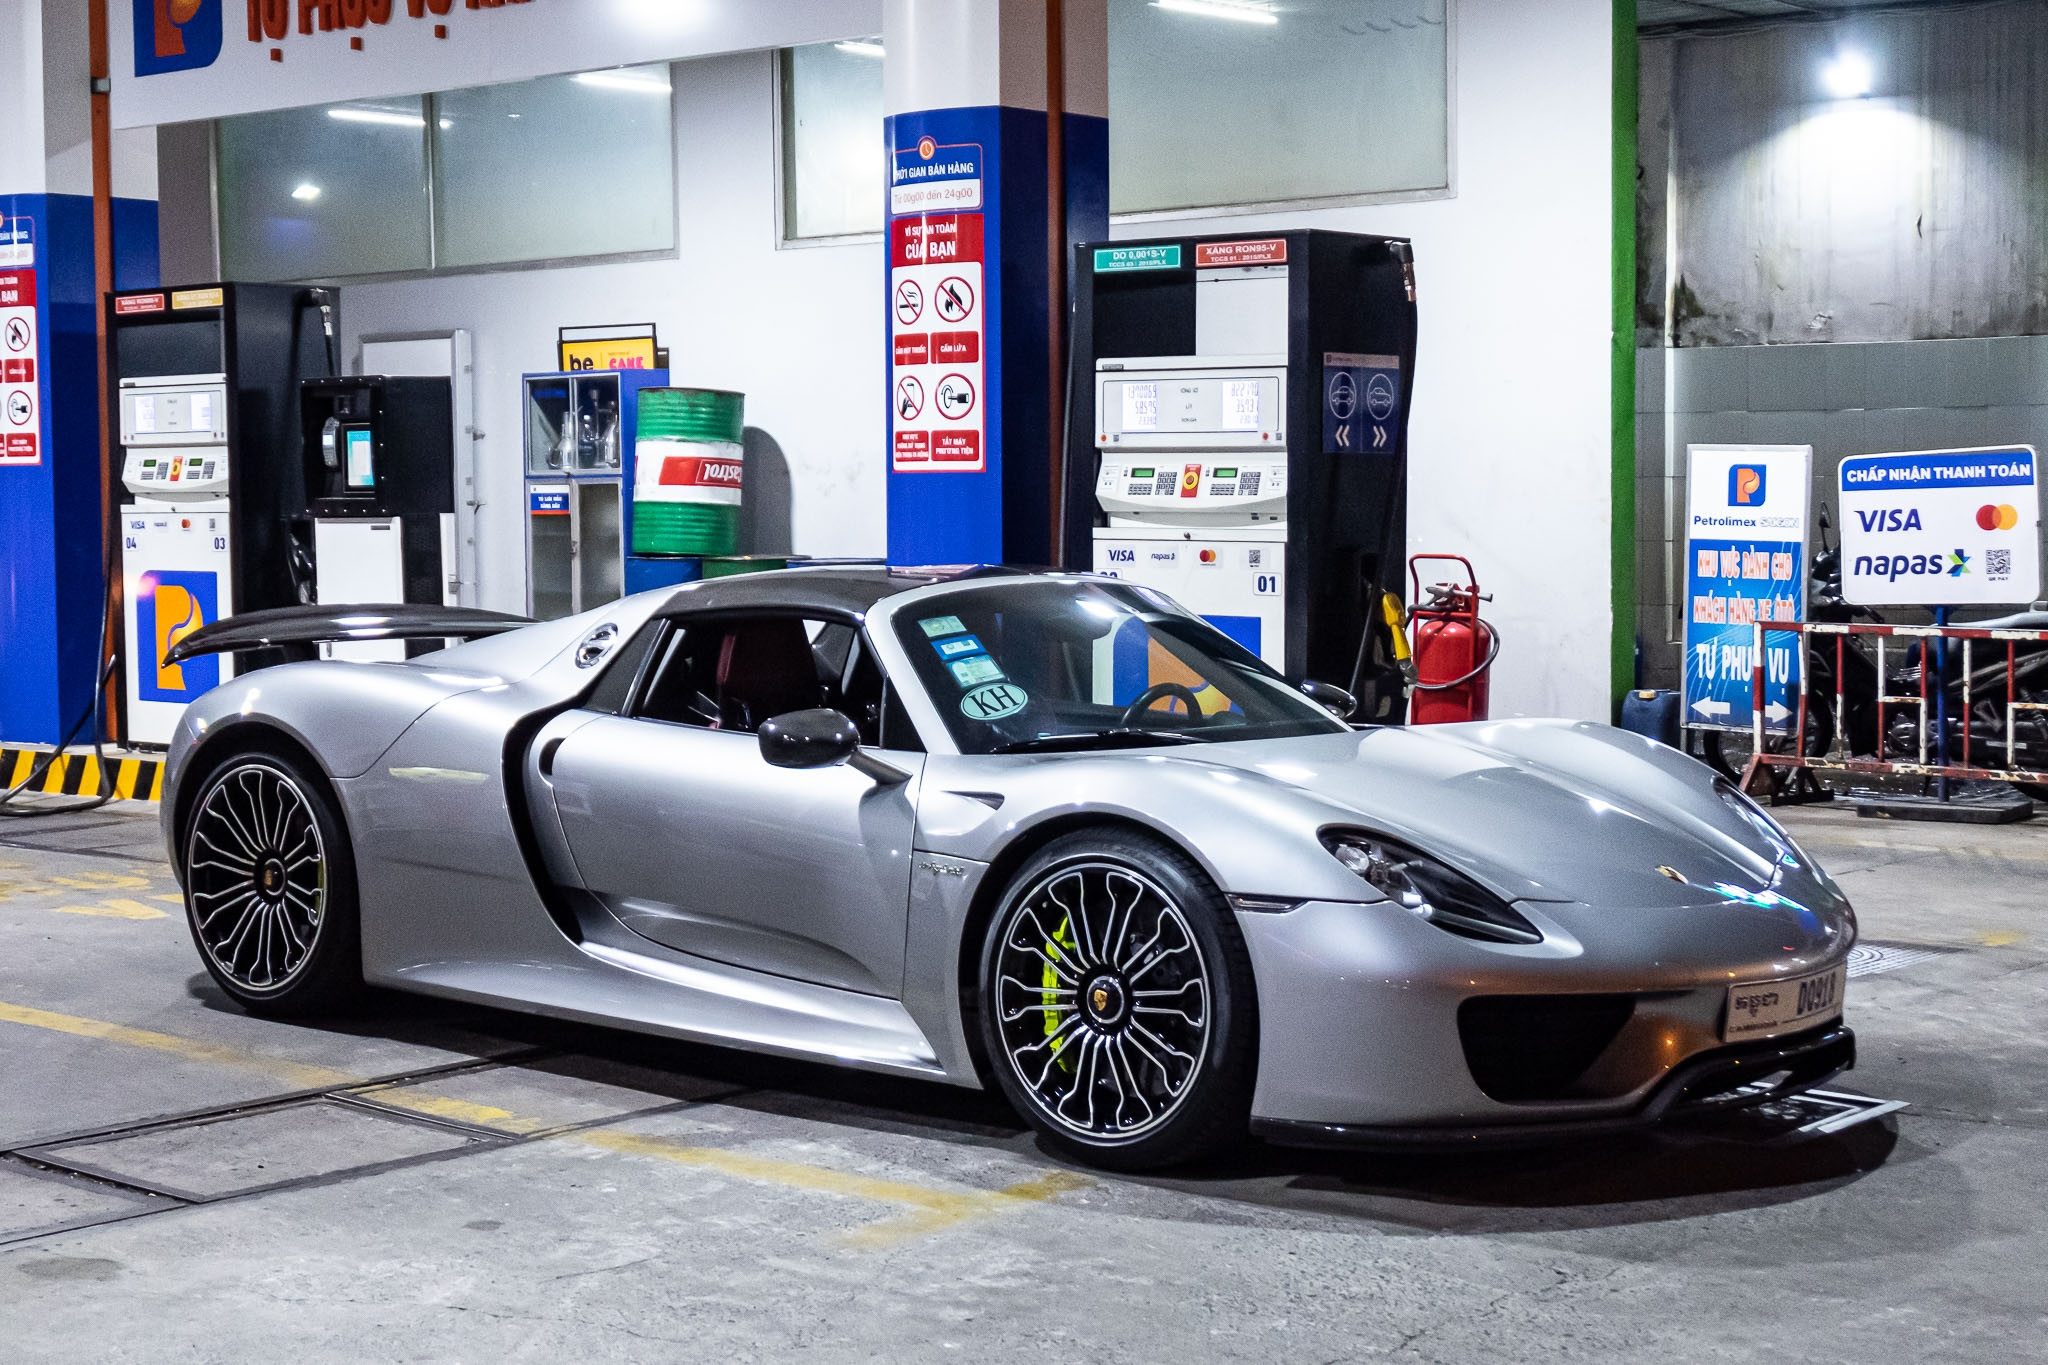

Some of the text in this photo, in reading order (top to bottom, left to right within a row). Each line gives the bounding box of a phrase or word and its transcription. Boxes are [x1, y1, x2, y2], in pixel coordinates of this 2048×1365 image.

[909, 166, 926, 178] GIAN
[928, 162, 946, 175] BÁN
[948, 161, 974, 174] HÀNG
[944, 187, 973, 200] 24g00
[930, 241, 956, 260] BẠN
[1113, 251, 1126, 260] DO
[1235, 243, 1277, 253] RON95-V
[569, 354, 594, 370] be
[1847, 461, 2030, 483] CHẤP NHẬN THANH TOÁN
[1694, 515, 1756, 527] Petrolimex
[1854, 508, 1922, 532] VISA
[126, 537, 137, 549] 04
[214, 537, 226, 549] 03
[1107, 549, 1135, 561] VISA
[1697, 544, 1793, 587] KHU VỰC DÀNH CHO
[1854, 554, 1943, 583] napas
[1257, 575, 1276, 593] 01
[1693, 589, 1727, 624] KHÁCH
[1728, 590, 1755, 625] HÀNG
[1757, 598, 1773, 622] XE
[1721, 644, 1753, 693] PHỤ
[1768, 647, 1790, 696] VỤ
[967, 685, 1020, 717] KH
